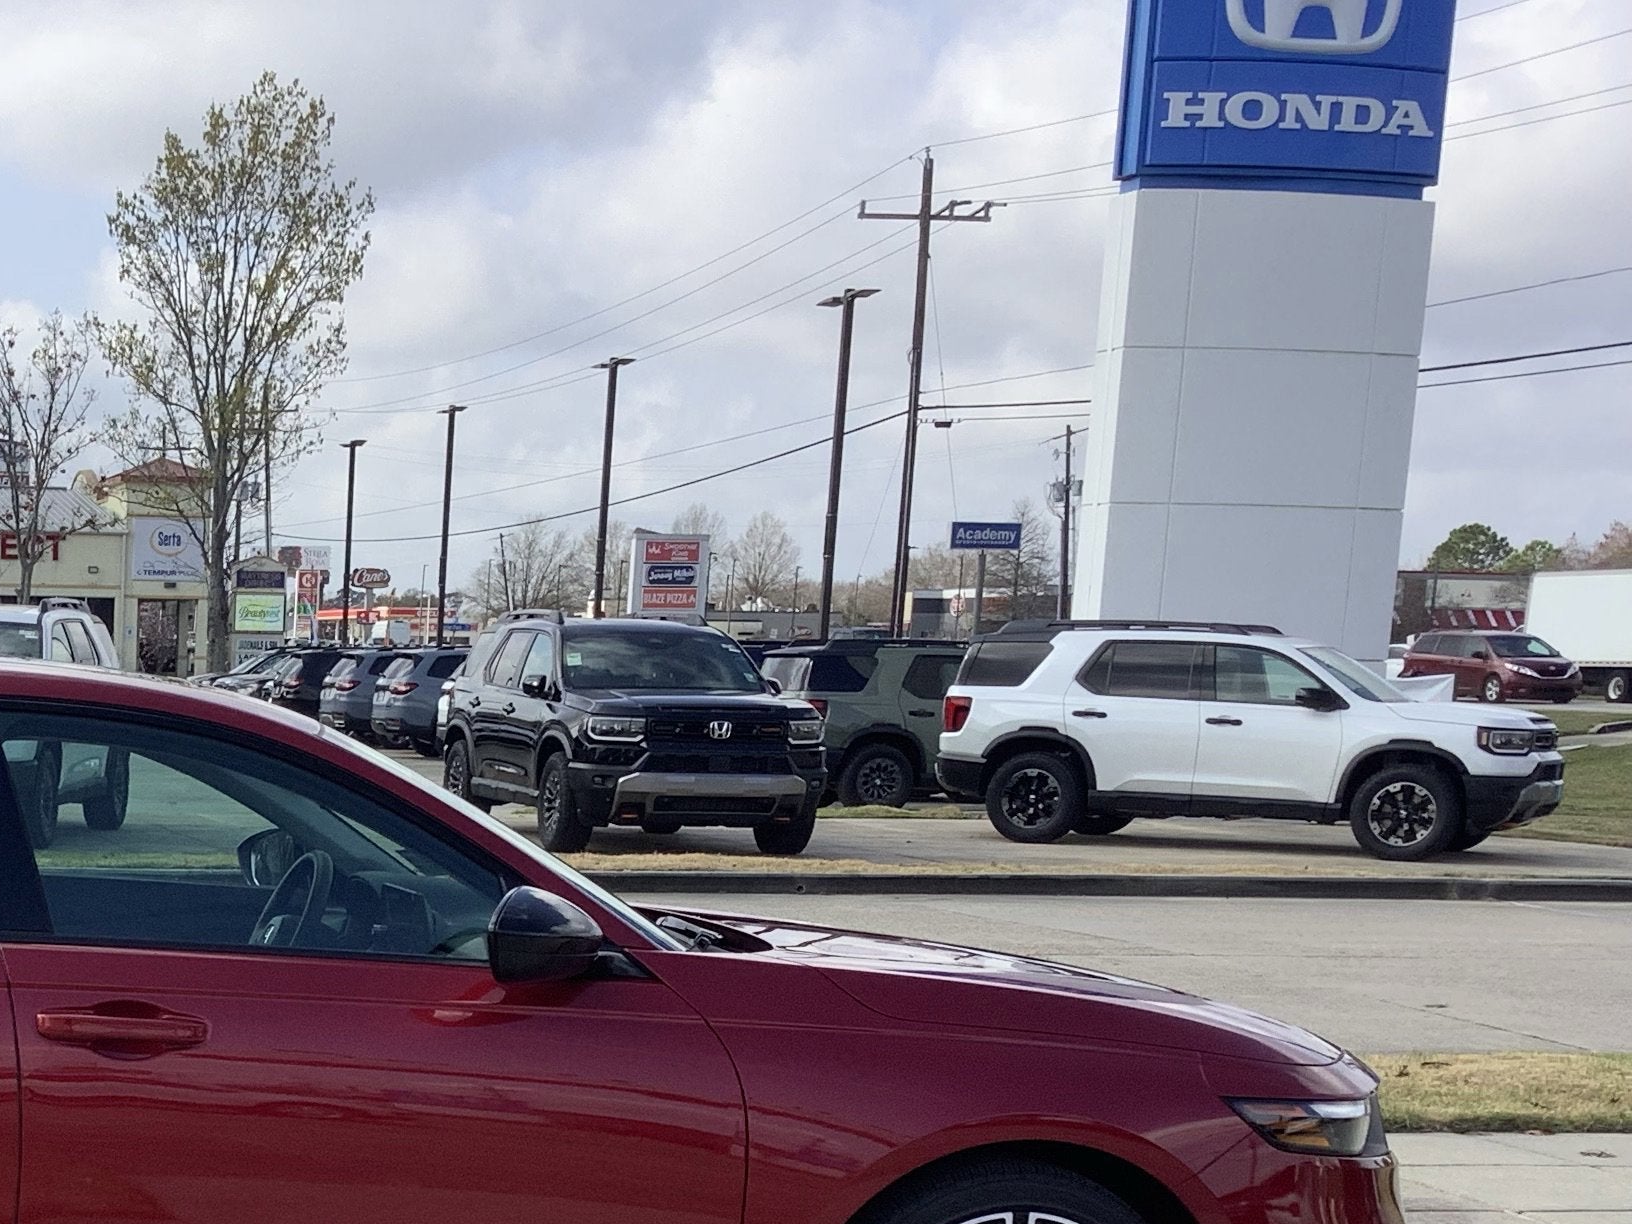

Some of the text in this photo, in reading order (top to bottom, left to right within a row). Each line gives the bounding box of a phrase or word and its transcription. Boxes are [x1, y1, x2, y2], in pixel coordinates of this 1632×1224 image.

[1161, 91, 1434, 137] HONDA
[158, 531, 181, 546] Serta
[956, 528, 1017, 543] Academy
[353, 568, 389, 586] Cane's
[644, 593, 687, 603] BLAZE PIZZA
